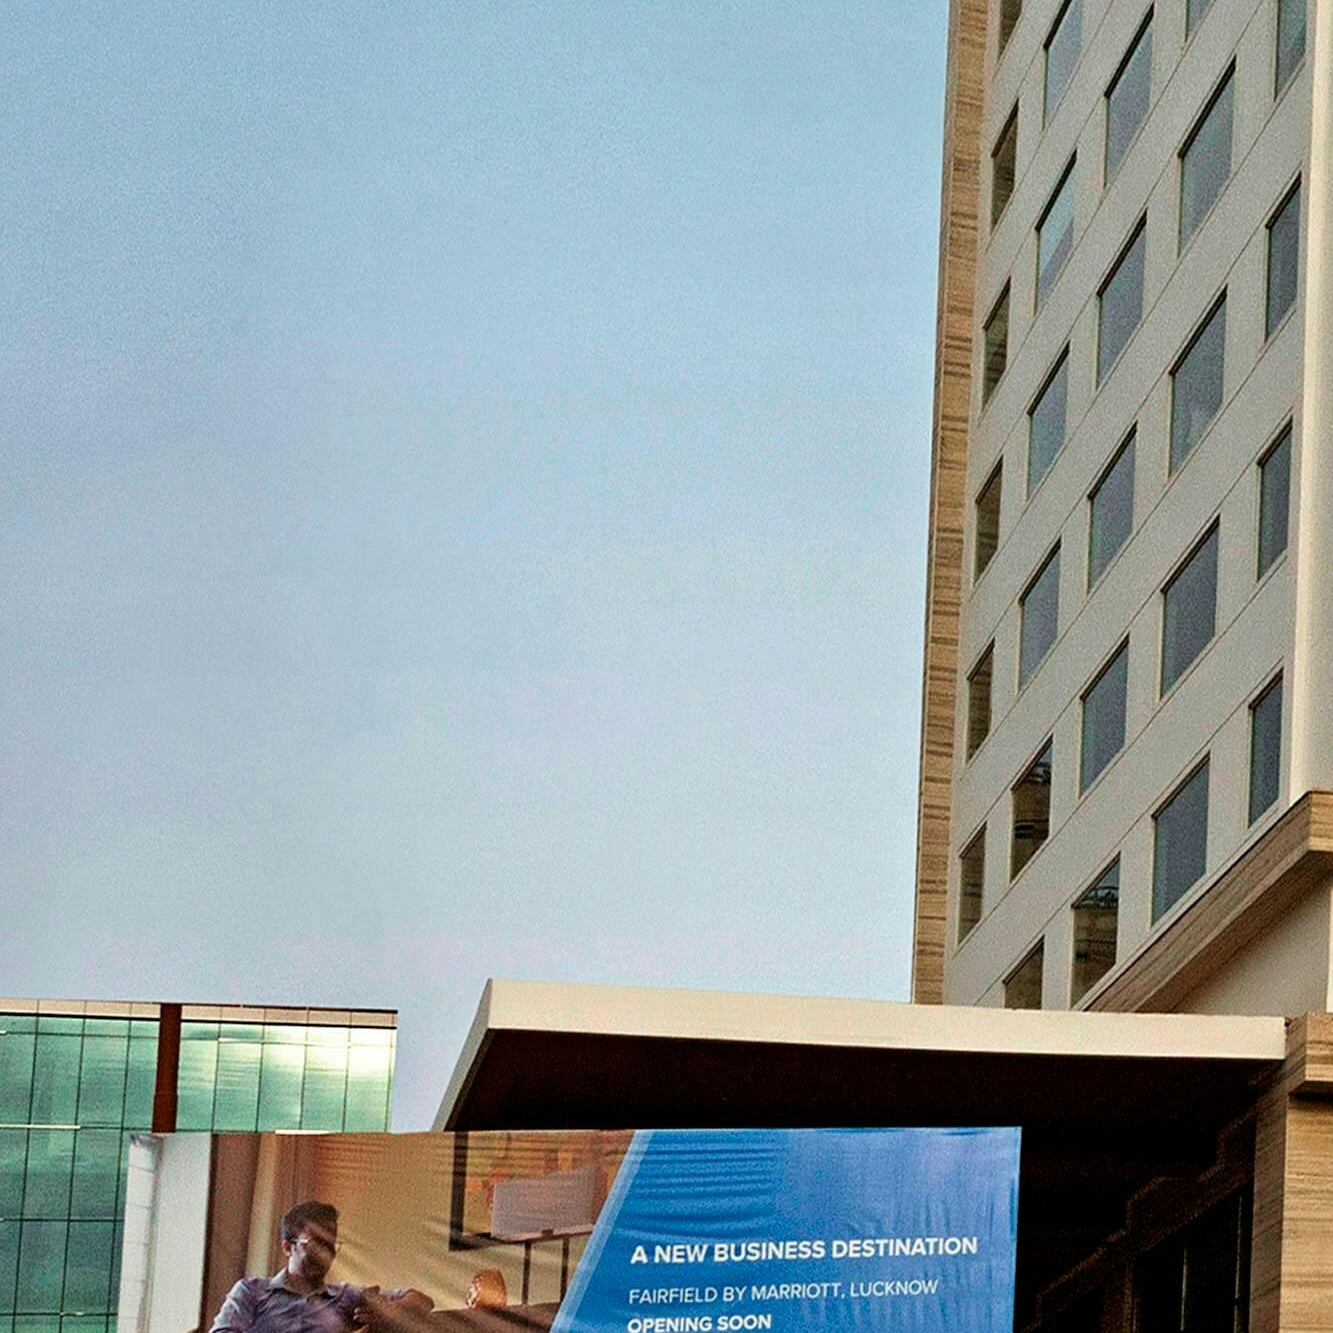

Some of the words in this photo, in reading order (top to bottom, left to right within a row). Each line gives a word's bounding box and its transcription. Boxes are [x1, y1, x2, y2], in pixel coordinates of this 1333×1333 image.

[630, 1246, 648, 1264] A
[654, 1244, 709, 1263] NEW
[713, 1240, 826, 1262] BUSINESS
[832, 1237, 978, 1259] DESTINATION
[629, 1287, 717, 1305] FAIRFIELD
[723, 1285, 747, 1302] BY
[850, 1279, 939, 1299] LUCKNOW
[627, 1316, 713, 1333] OPENING
[717, 1314, 772, 1330] SOON
